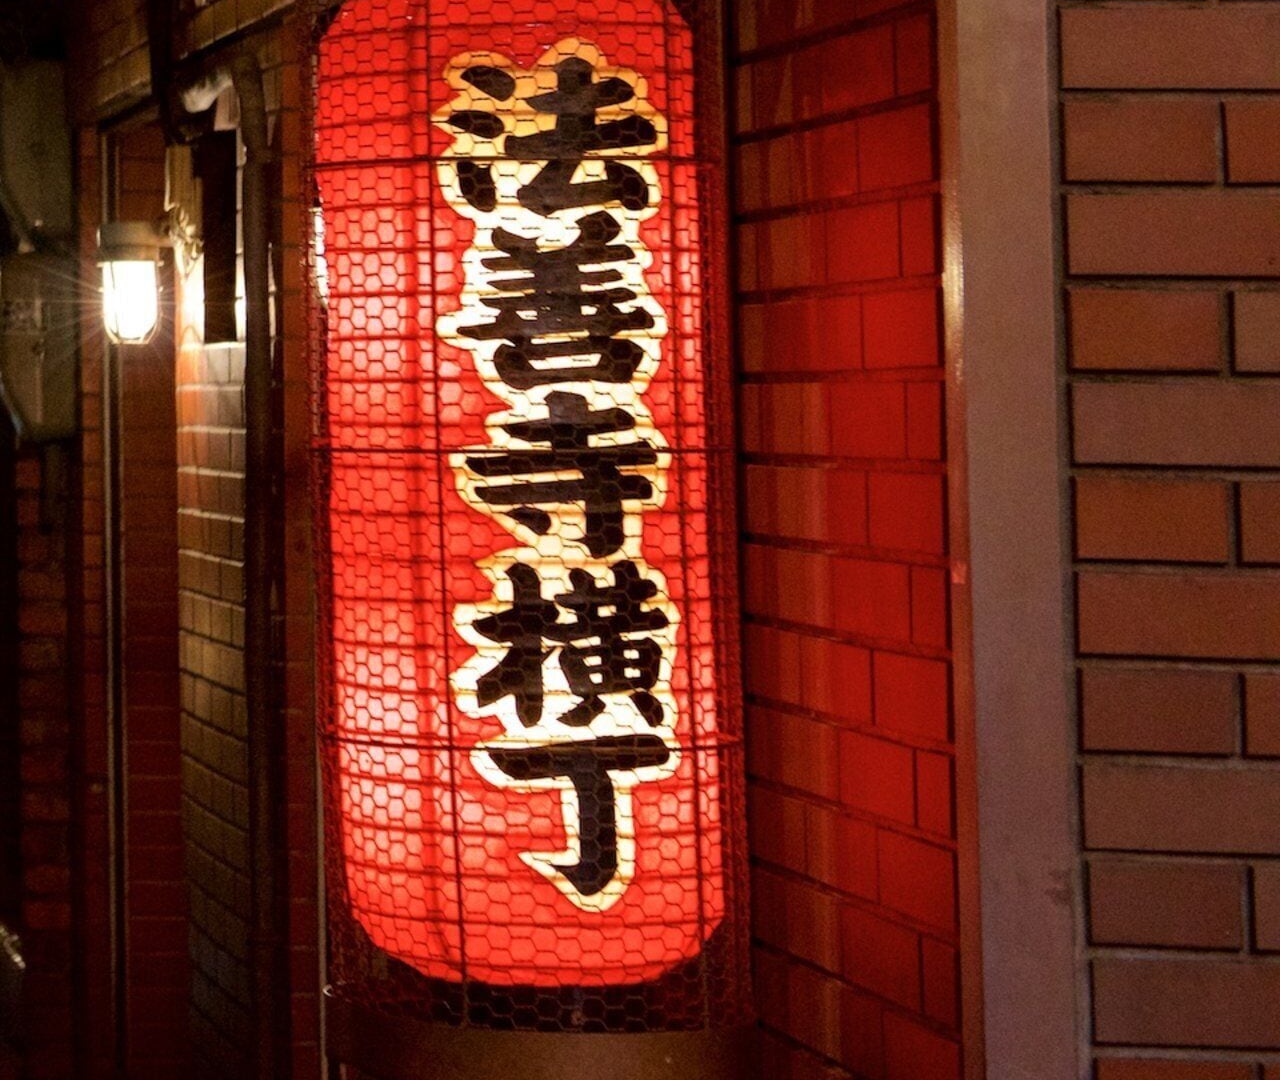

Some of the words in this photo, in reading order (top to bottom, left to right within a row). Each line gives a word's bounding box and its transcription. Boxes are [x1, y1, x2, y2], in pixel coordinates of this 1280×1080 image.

[447, 56, 672, 898] 法善寺横丁
